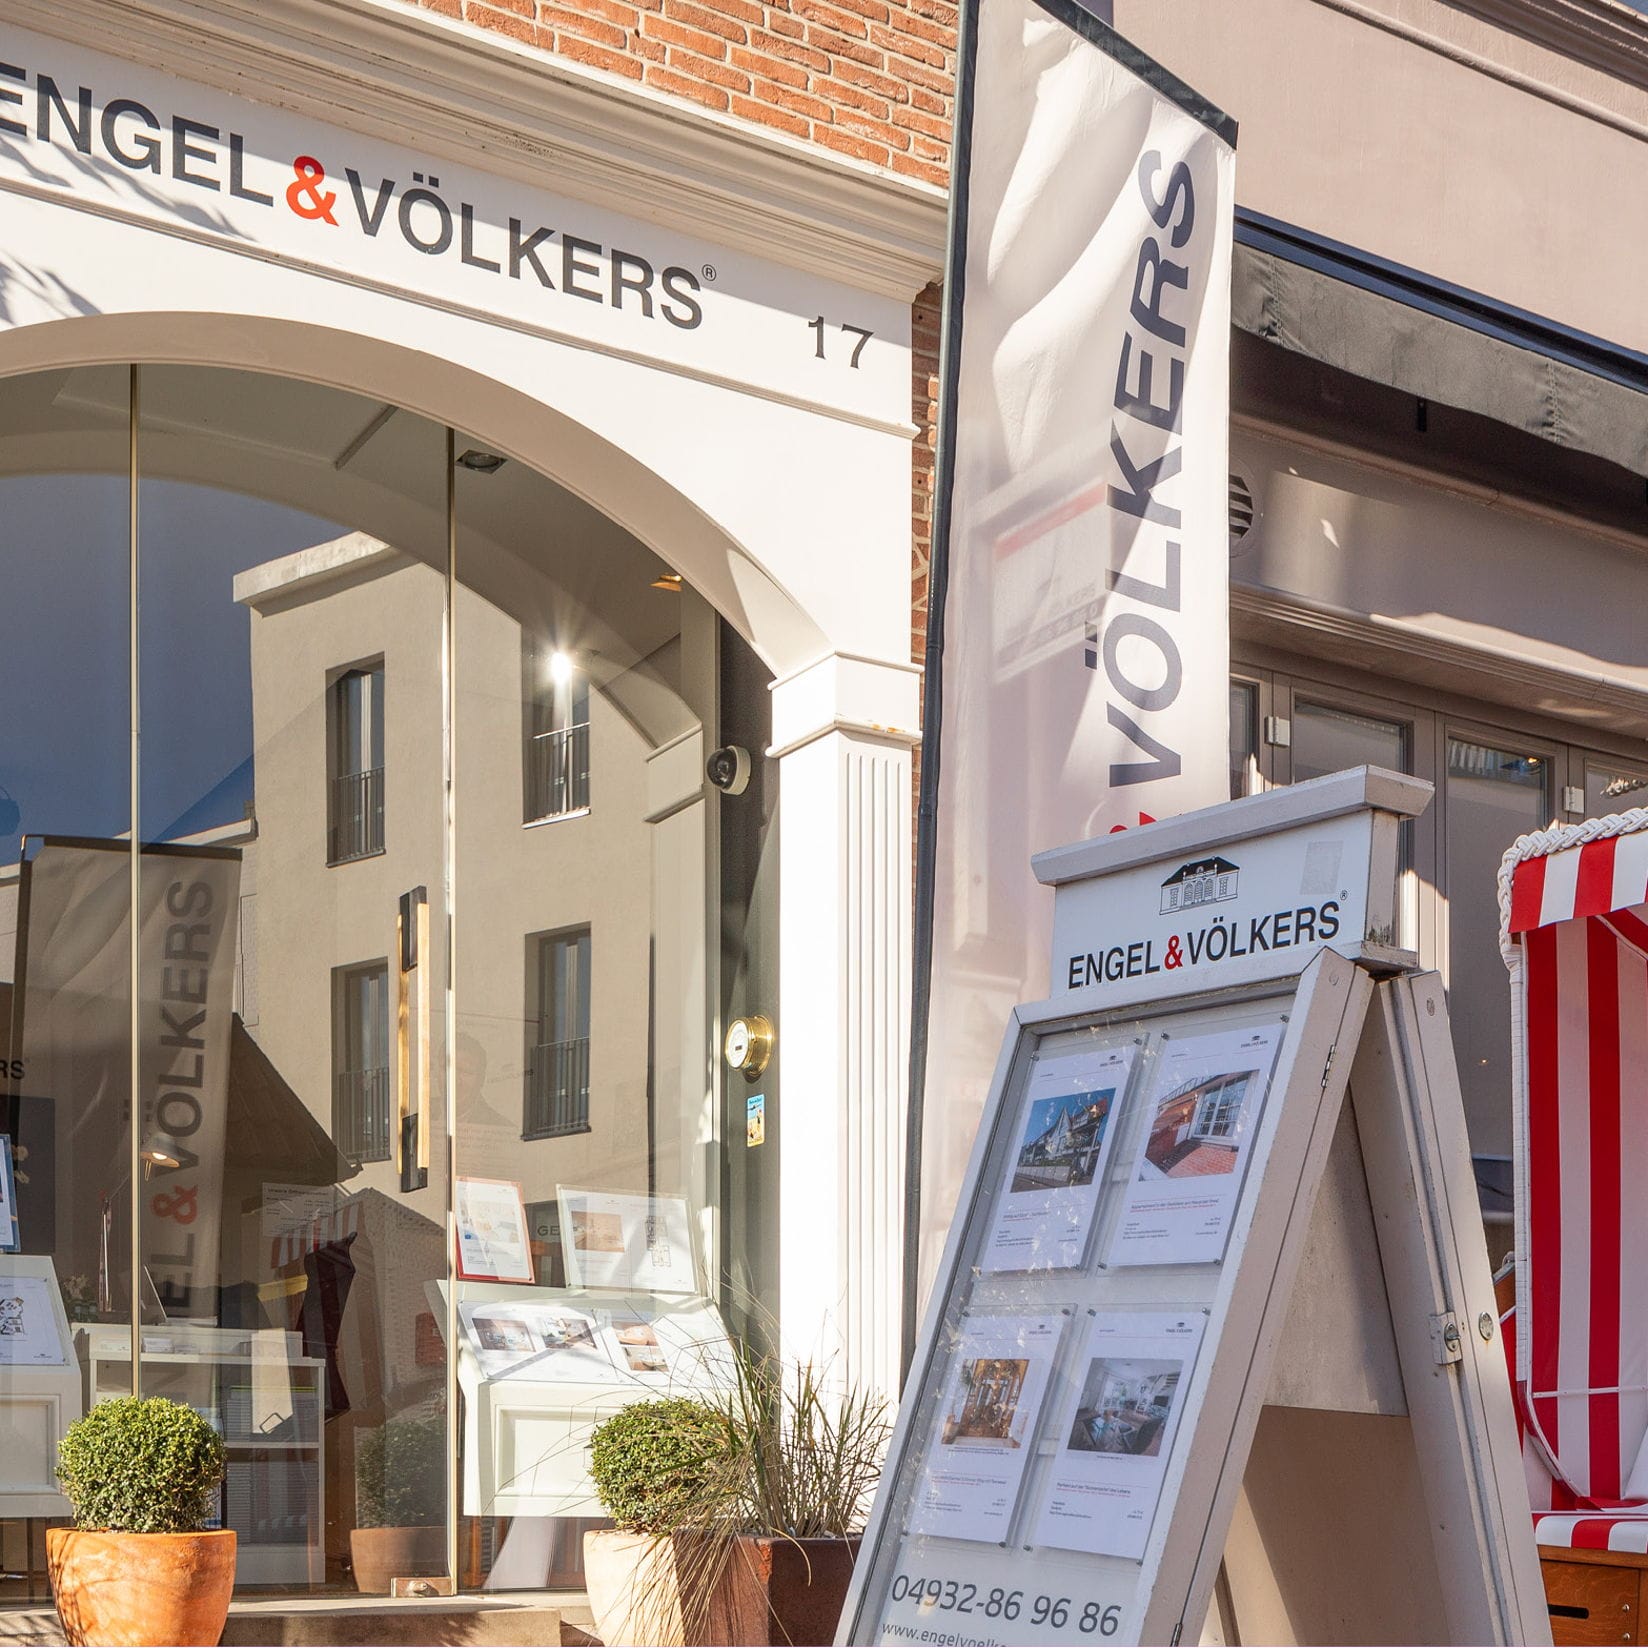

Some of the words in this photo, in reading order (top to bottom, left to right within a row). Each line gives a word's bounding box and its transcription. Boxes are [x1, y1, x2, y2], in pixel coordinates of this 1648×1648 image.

[808, 315, 874, 369] 17
[1085, 149, 1195, 832] VÖLKERS
[891, 1575, 1024, 1621] 04932-86
[1030, 1596, 1071, 1628] 96
[1079, 1602, 1122, 1636] 86
